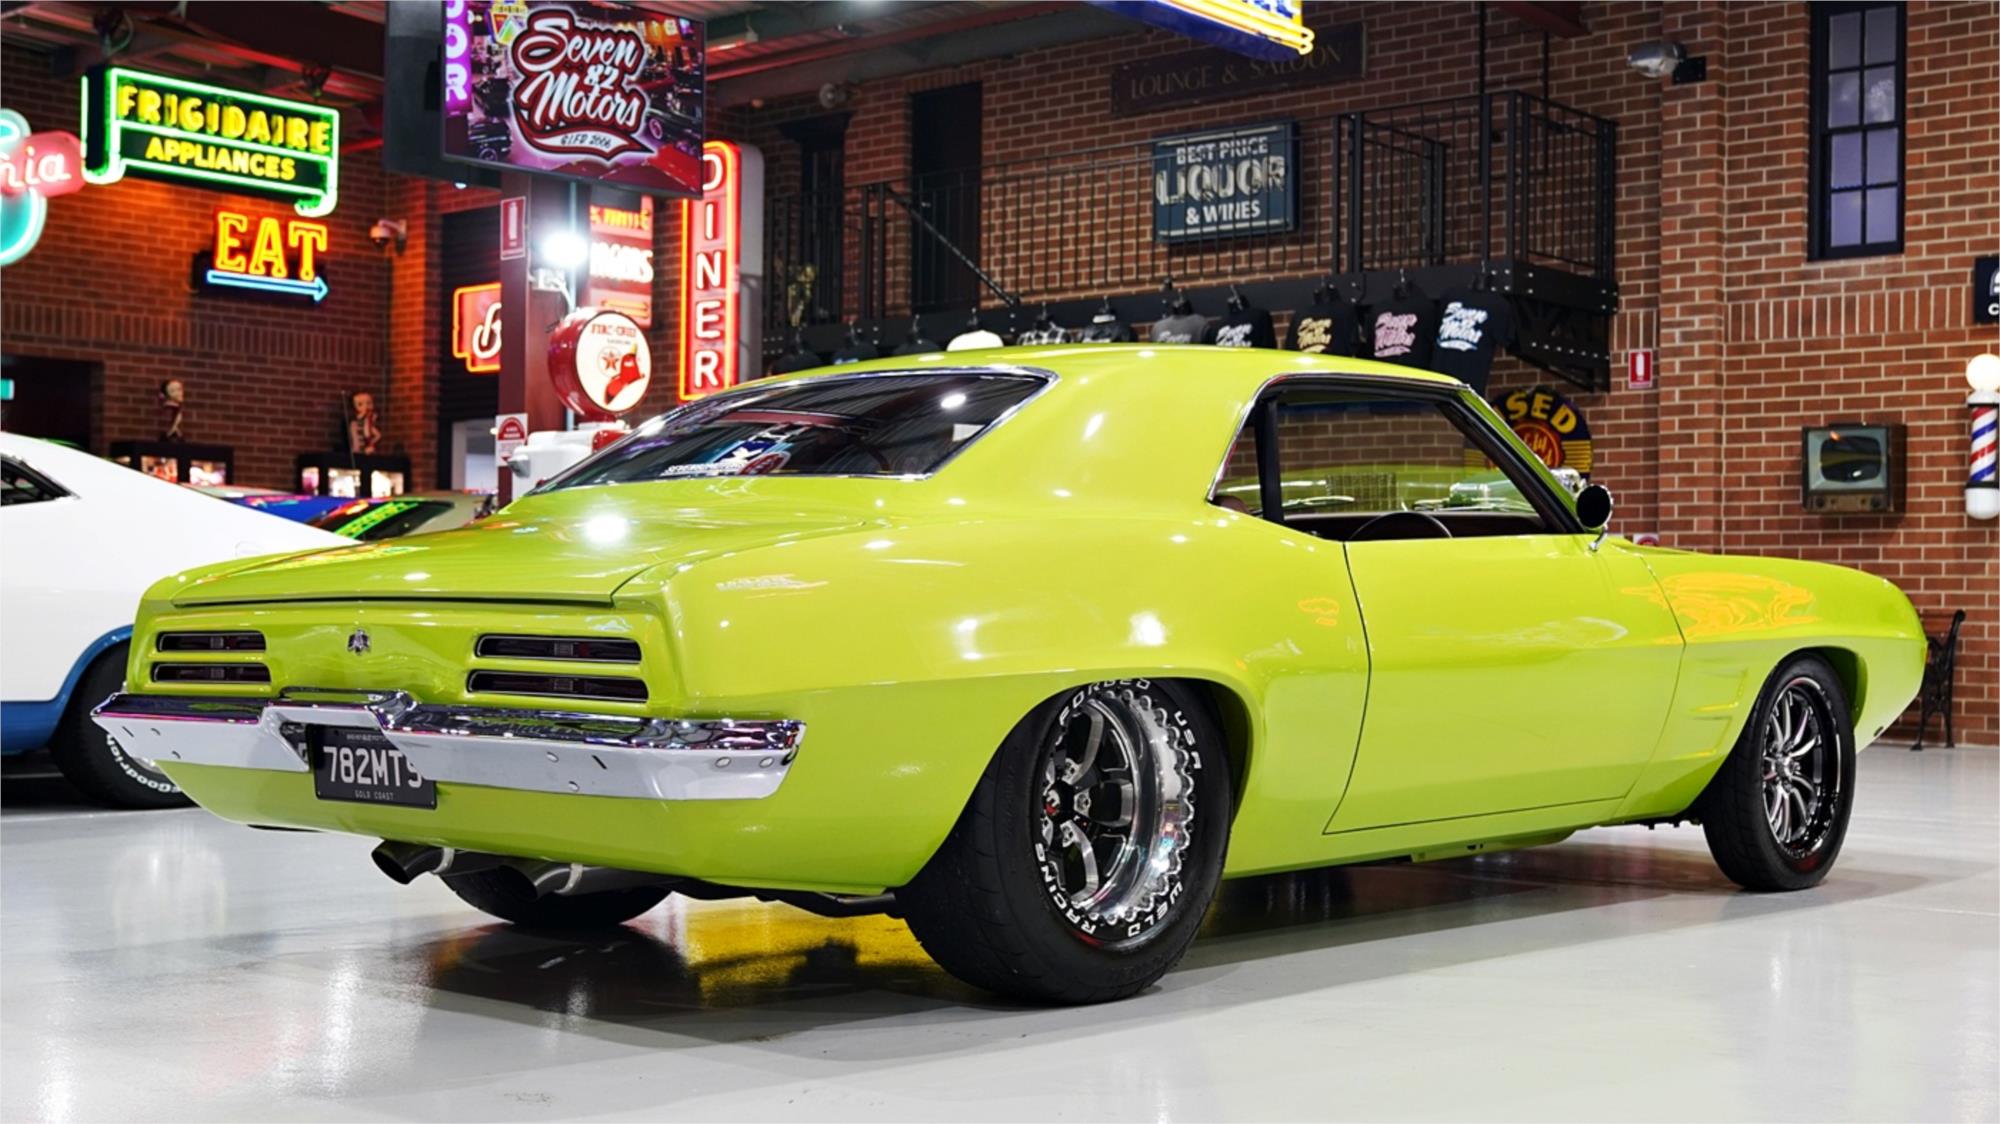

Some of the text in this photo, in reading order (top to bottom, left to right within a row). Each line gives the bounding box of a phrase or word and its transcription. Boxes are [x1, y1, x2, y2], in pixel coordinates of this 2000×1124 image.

[519, 17, 638, 72] Seven
[520, 70, 640, 126] Motors
[1131, 66, 1212, 100] LOUNGE
[1222, 64, 1239, 84] &
[118, 86, 330, 153] FRIGIDAIRE
[145, 137, 296, 181] APPLIANCES
[1176, 137, 1268, 164] BEST PRICE
[1156, 156, 1285, 206] LIQUOR
[1186, 200, 1260, 225] & WINES
[215, 211, 327, 281] EAT
[693, 154, 723, 388] DINER
[1493, 391, 1577, 433] SED
[374, 791, 394, 800] COAST
[1035, 843, 1182, 937] WELD RACING
